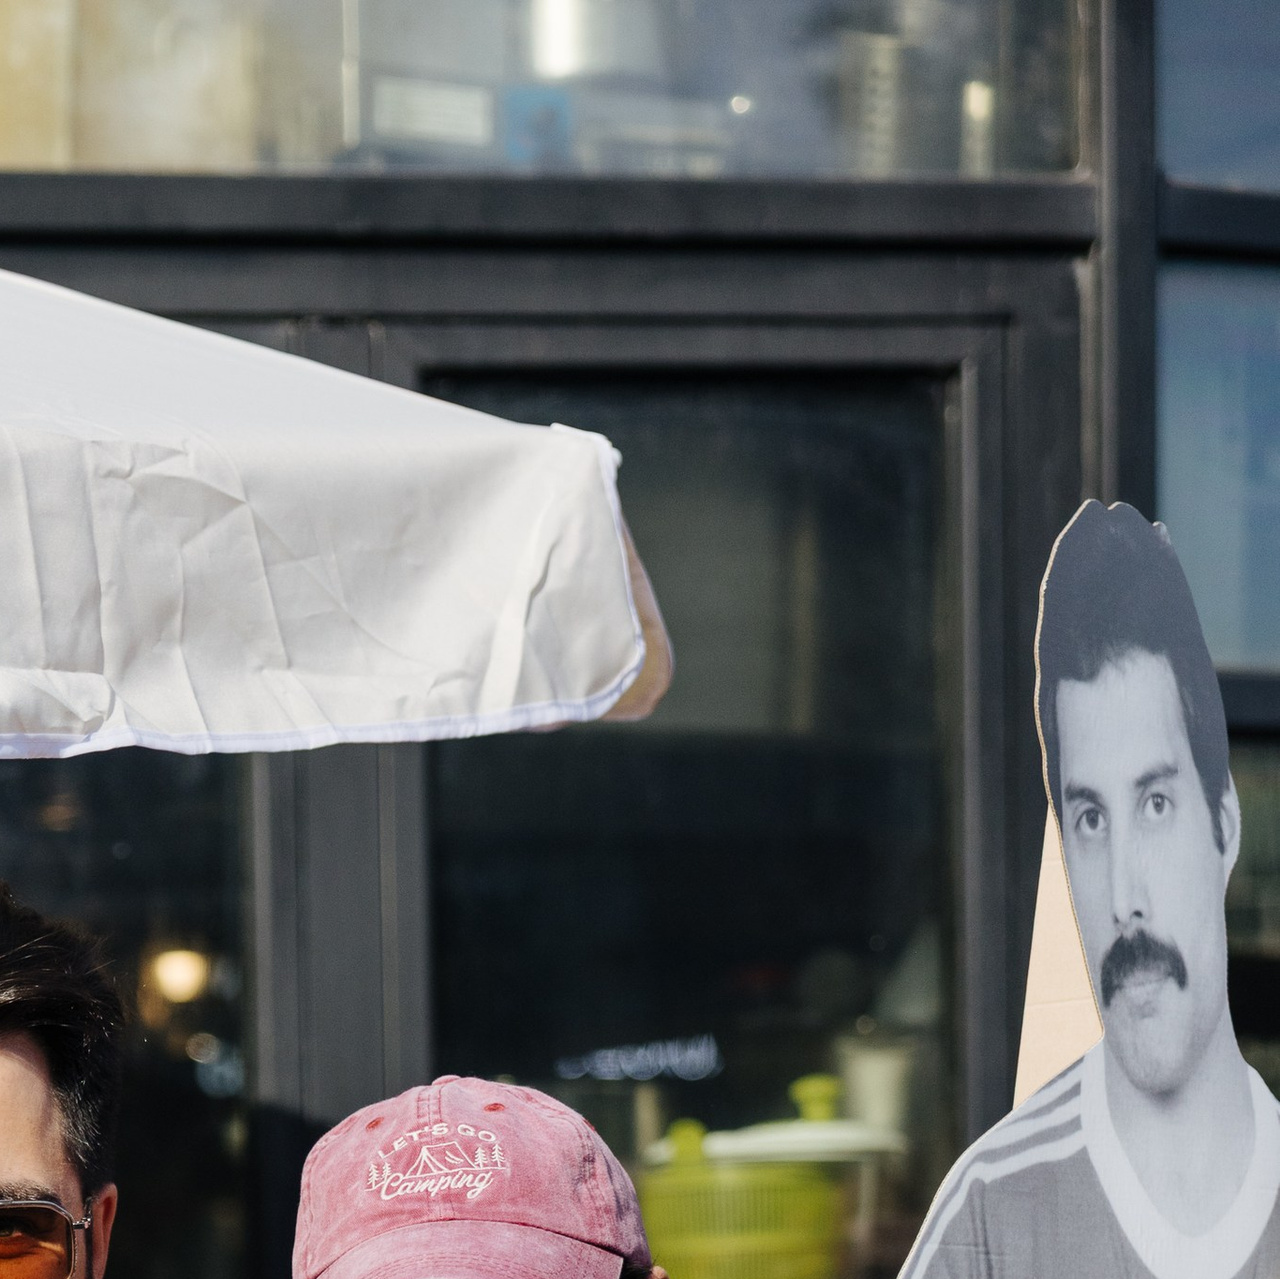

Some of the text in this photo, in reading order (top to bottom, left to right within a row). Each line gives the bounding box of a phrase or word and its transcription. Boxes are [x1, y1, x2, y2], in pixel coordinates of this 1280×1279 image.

[378, 1122, 497, 1159] LET'S GO
[380, 1171, 494, 1200] Camping
